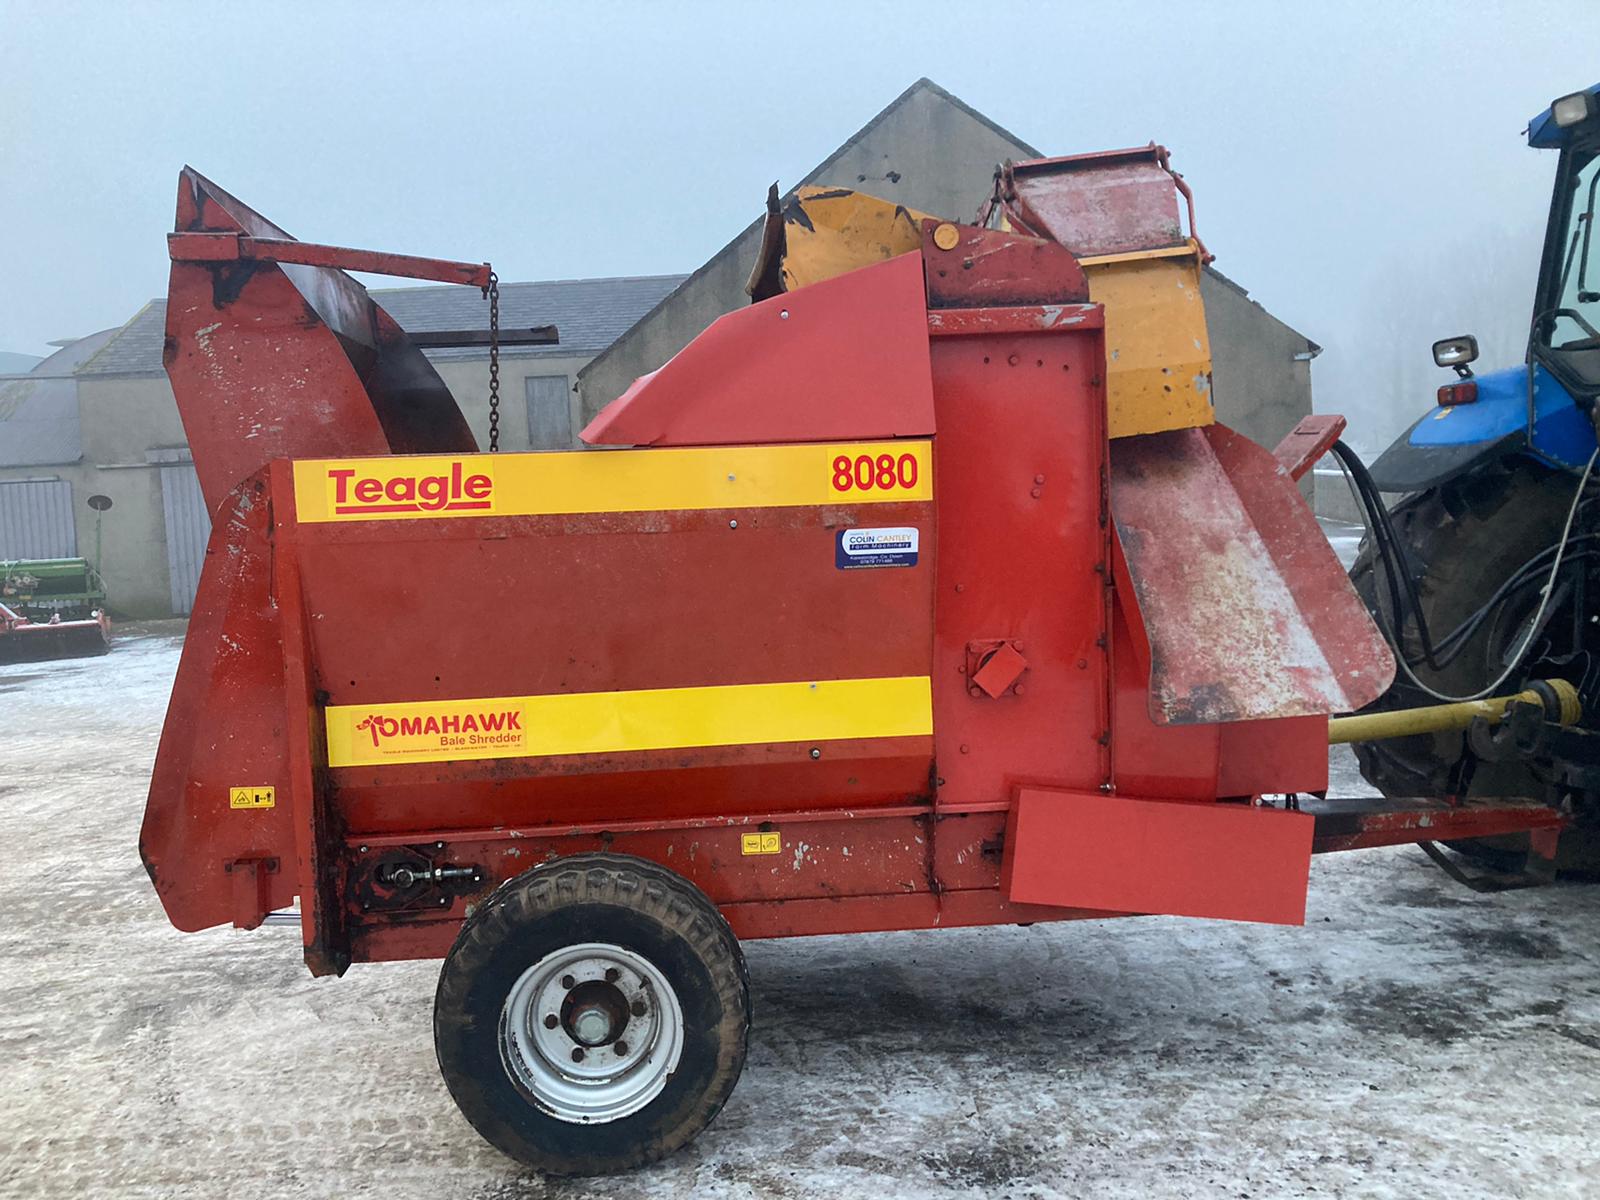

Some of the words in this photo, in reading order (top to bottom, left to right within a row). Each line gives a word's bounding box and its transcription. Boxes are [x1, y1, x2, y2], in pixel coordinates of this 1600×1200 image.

[832, 453, 918, 492] 8080
[328, 462, 493, 511] Teagle
[849, 536, 875, 544] COLIN
[876, 534, 912, 543] CANTLEY
[440, 736, 466, 746] Bale
[469, 733, 522, 744] Shredder
